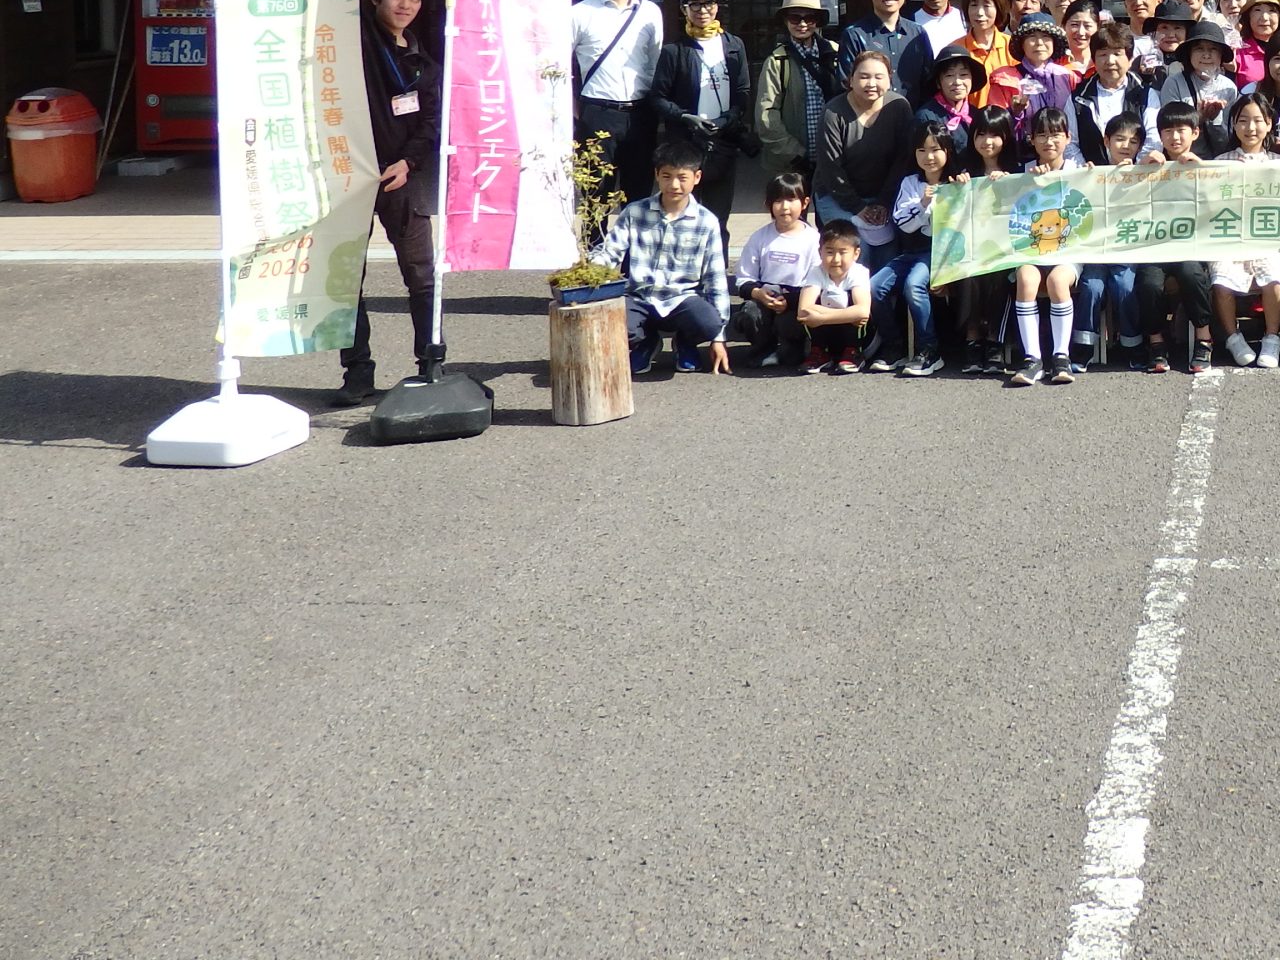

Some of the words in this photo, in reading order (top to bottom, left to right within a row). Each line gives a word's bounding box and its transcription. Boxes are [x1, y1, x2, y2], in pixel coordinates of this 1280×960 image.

[254, 28, 313, 235] 全国植樹祭
[1115, 217, 1196, 244] 第76回
[258, 256, 310, 279] 2026
[256, 303, 309, 322] 愛媛県
